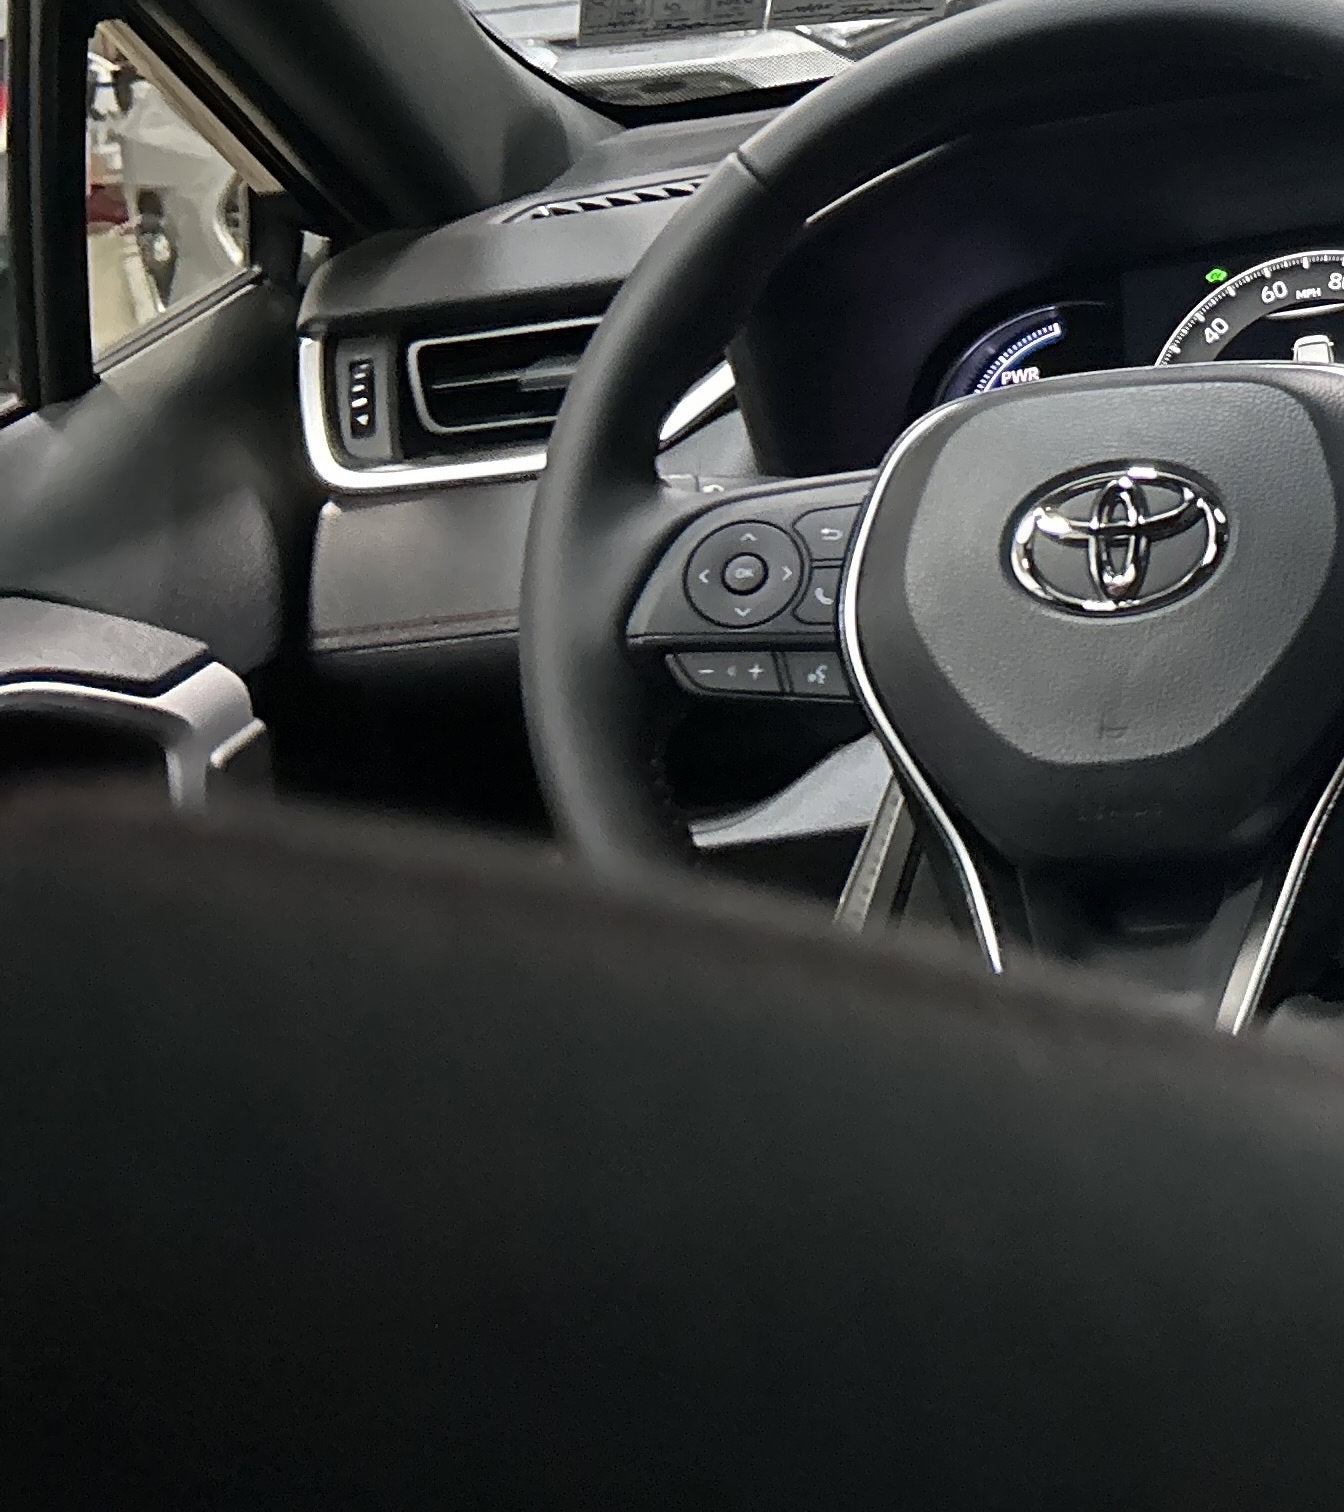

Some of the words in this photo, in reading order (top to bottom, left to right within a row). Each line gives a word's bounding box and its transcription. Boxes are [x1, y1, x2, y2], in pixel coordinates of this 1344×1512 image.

[1259, 279, 1289, 305] 60
[1294, 285, 1322, 300] MPH
[1202, 316, 1230, 345] 40
[1000, 366, 1041, 386] PWR
